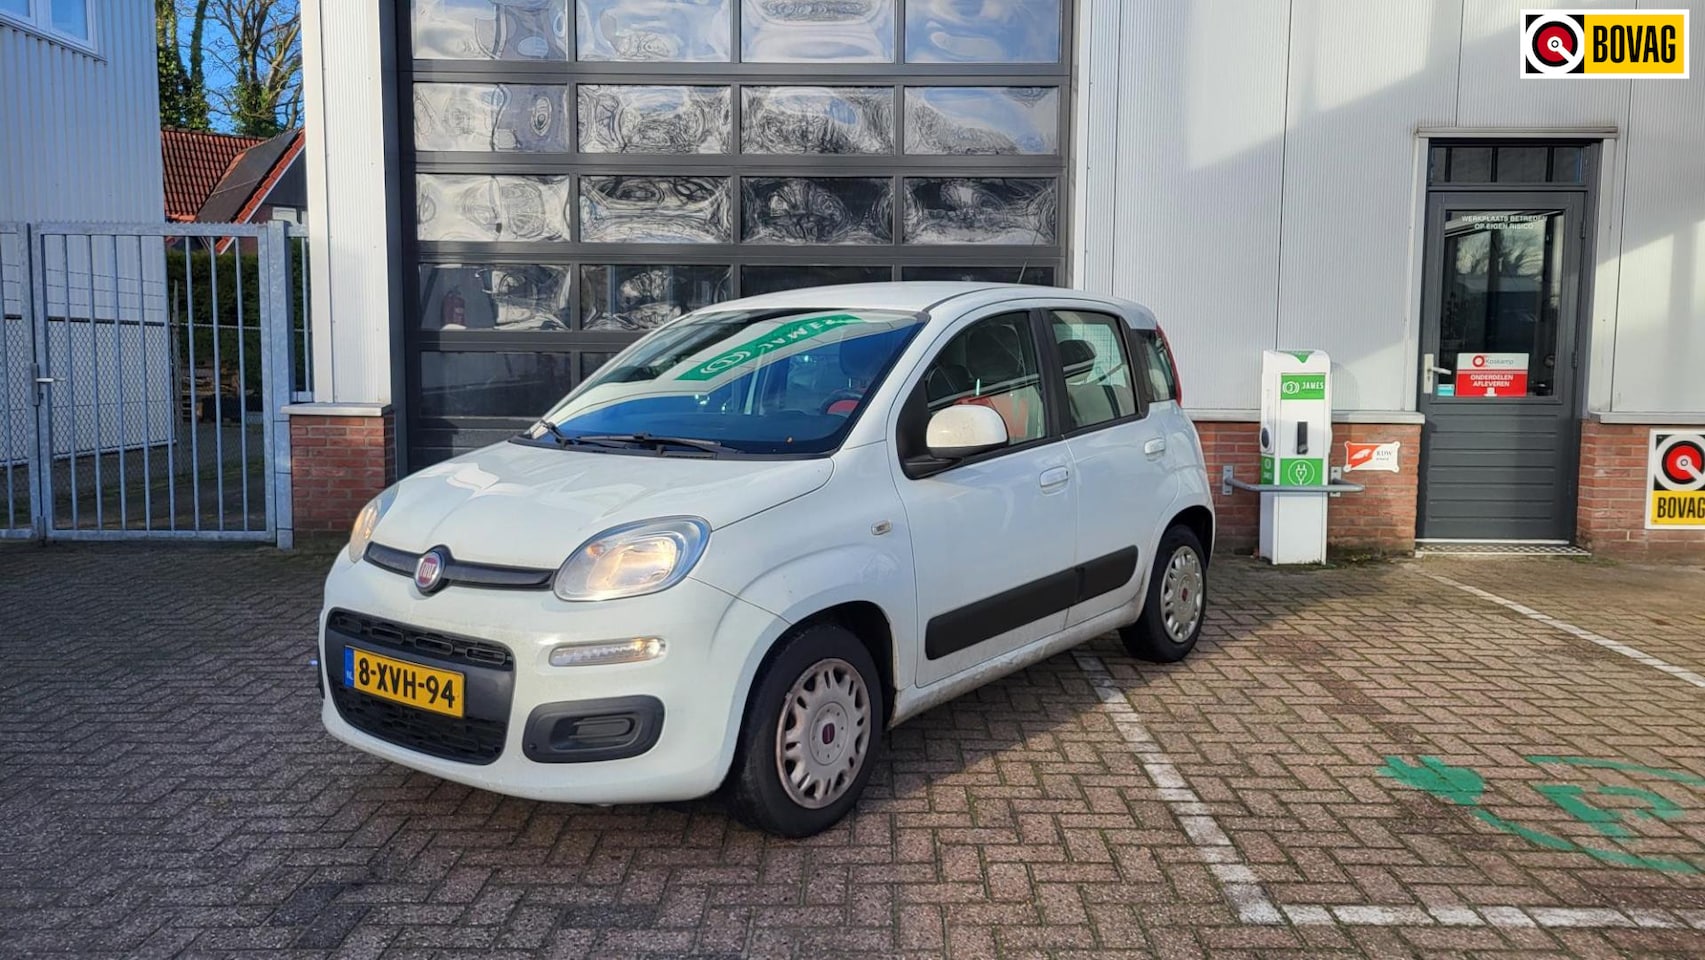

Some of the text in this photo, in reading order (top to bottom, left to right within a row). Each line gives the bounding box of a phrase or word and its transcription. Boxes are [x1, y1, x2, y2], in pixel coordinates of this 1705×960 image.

[1301, 381, 1324, 390] JAMES
[1656, 496, 1705, 518] BOVAG
[421, 562, 437, 577] FIAT
[358, 657, 456, 709] 8-XVH-94
